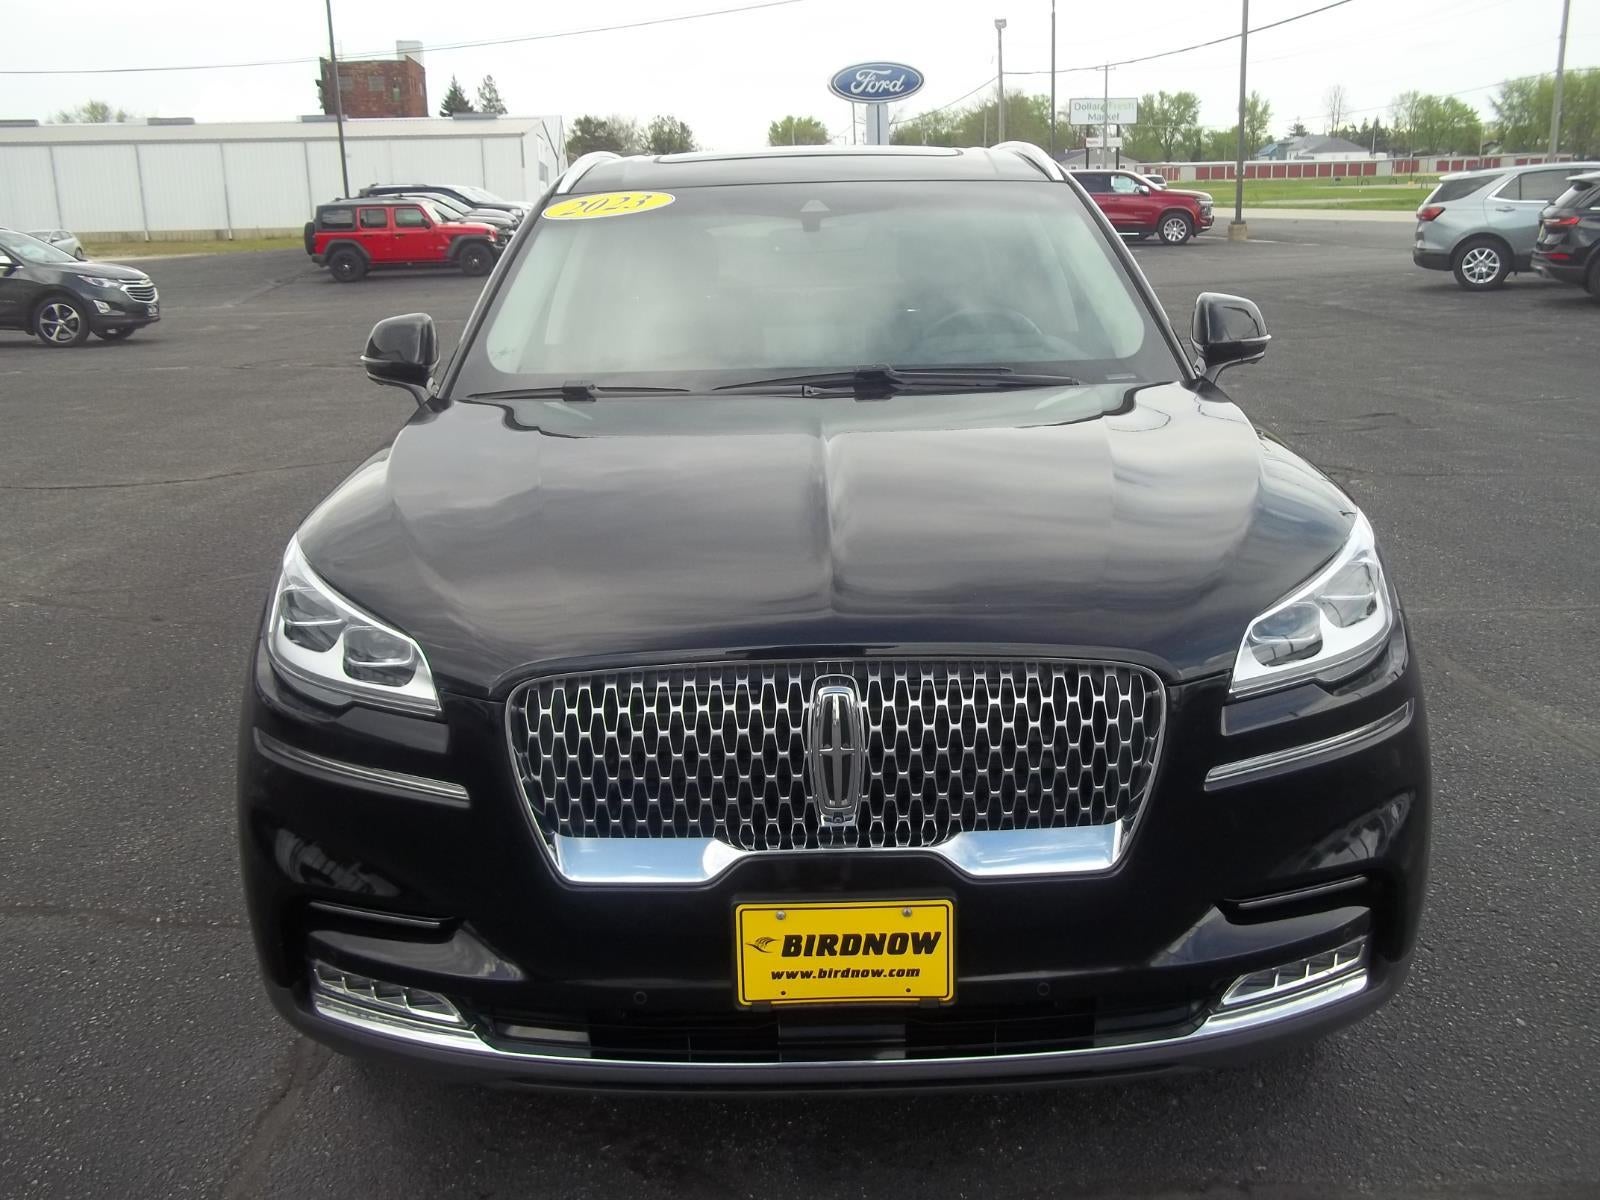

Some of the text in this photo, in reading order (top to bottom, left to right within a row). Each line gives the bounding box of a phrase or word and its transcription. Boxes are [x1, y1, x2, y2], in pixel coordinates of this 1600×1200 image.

[850, 69, 906, 94] Ford
[1074, 102, 1100, 111] Dollar
[560, 194, 652, 216] 2023
[781, 931, 942, 957] BIRDNOW
[771, 967, 920, 980] www.birdnow.com
